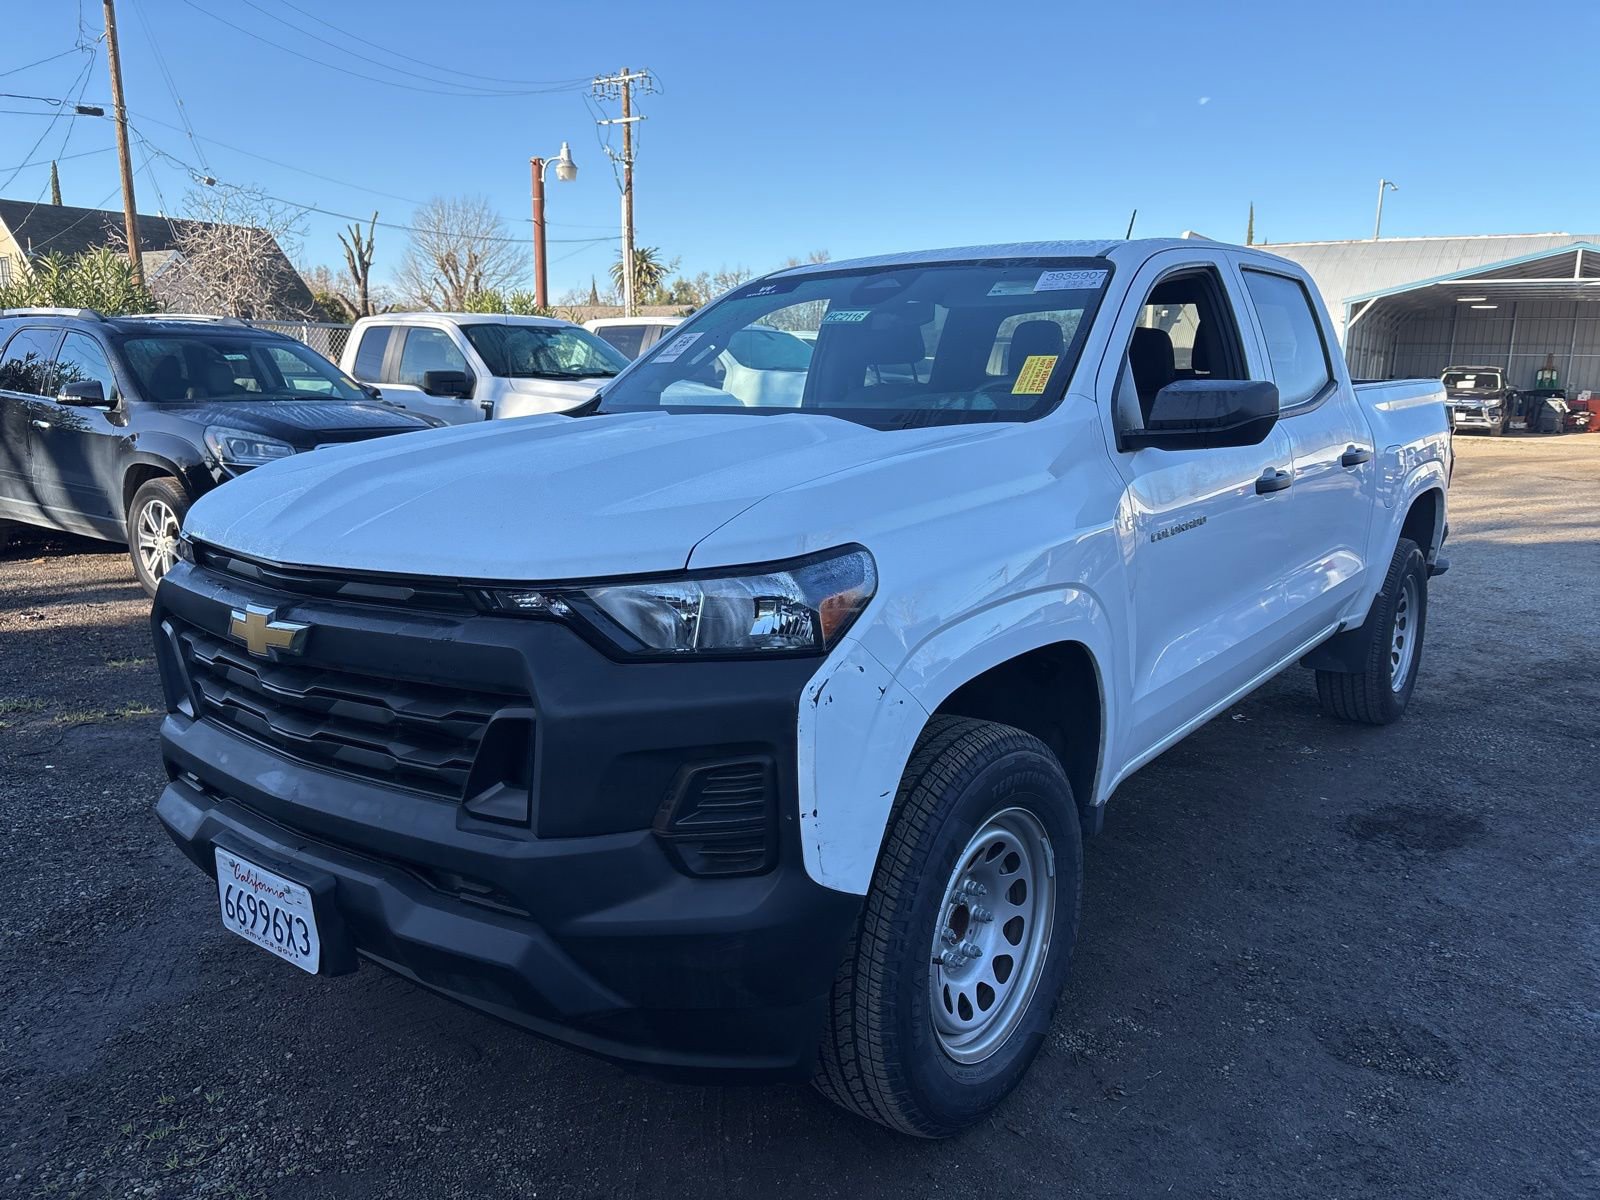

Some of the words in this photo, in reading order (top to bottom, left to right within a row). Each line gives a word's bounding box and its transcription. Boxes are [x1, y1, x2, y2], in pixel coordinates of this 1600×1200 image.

[1046, 271, 1107, 281] 3935907
[825, 312, 865, 321] HC2116
[234, 863, 290, 903] California
[225, 884, 311, 956] 66996X3
[244, 928, 294, 957] dmv.ca.gov
